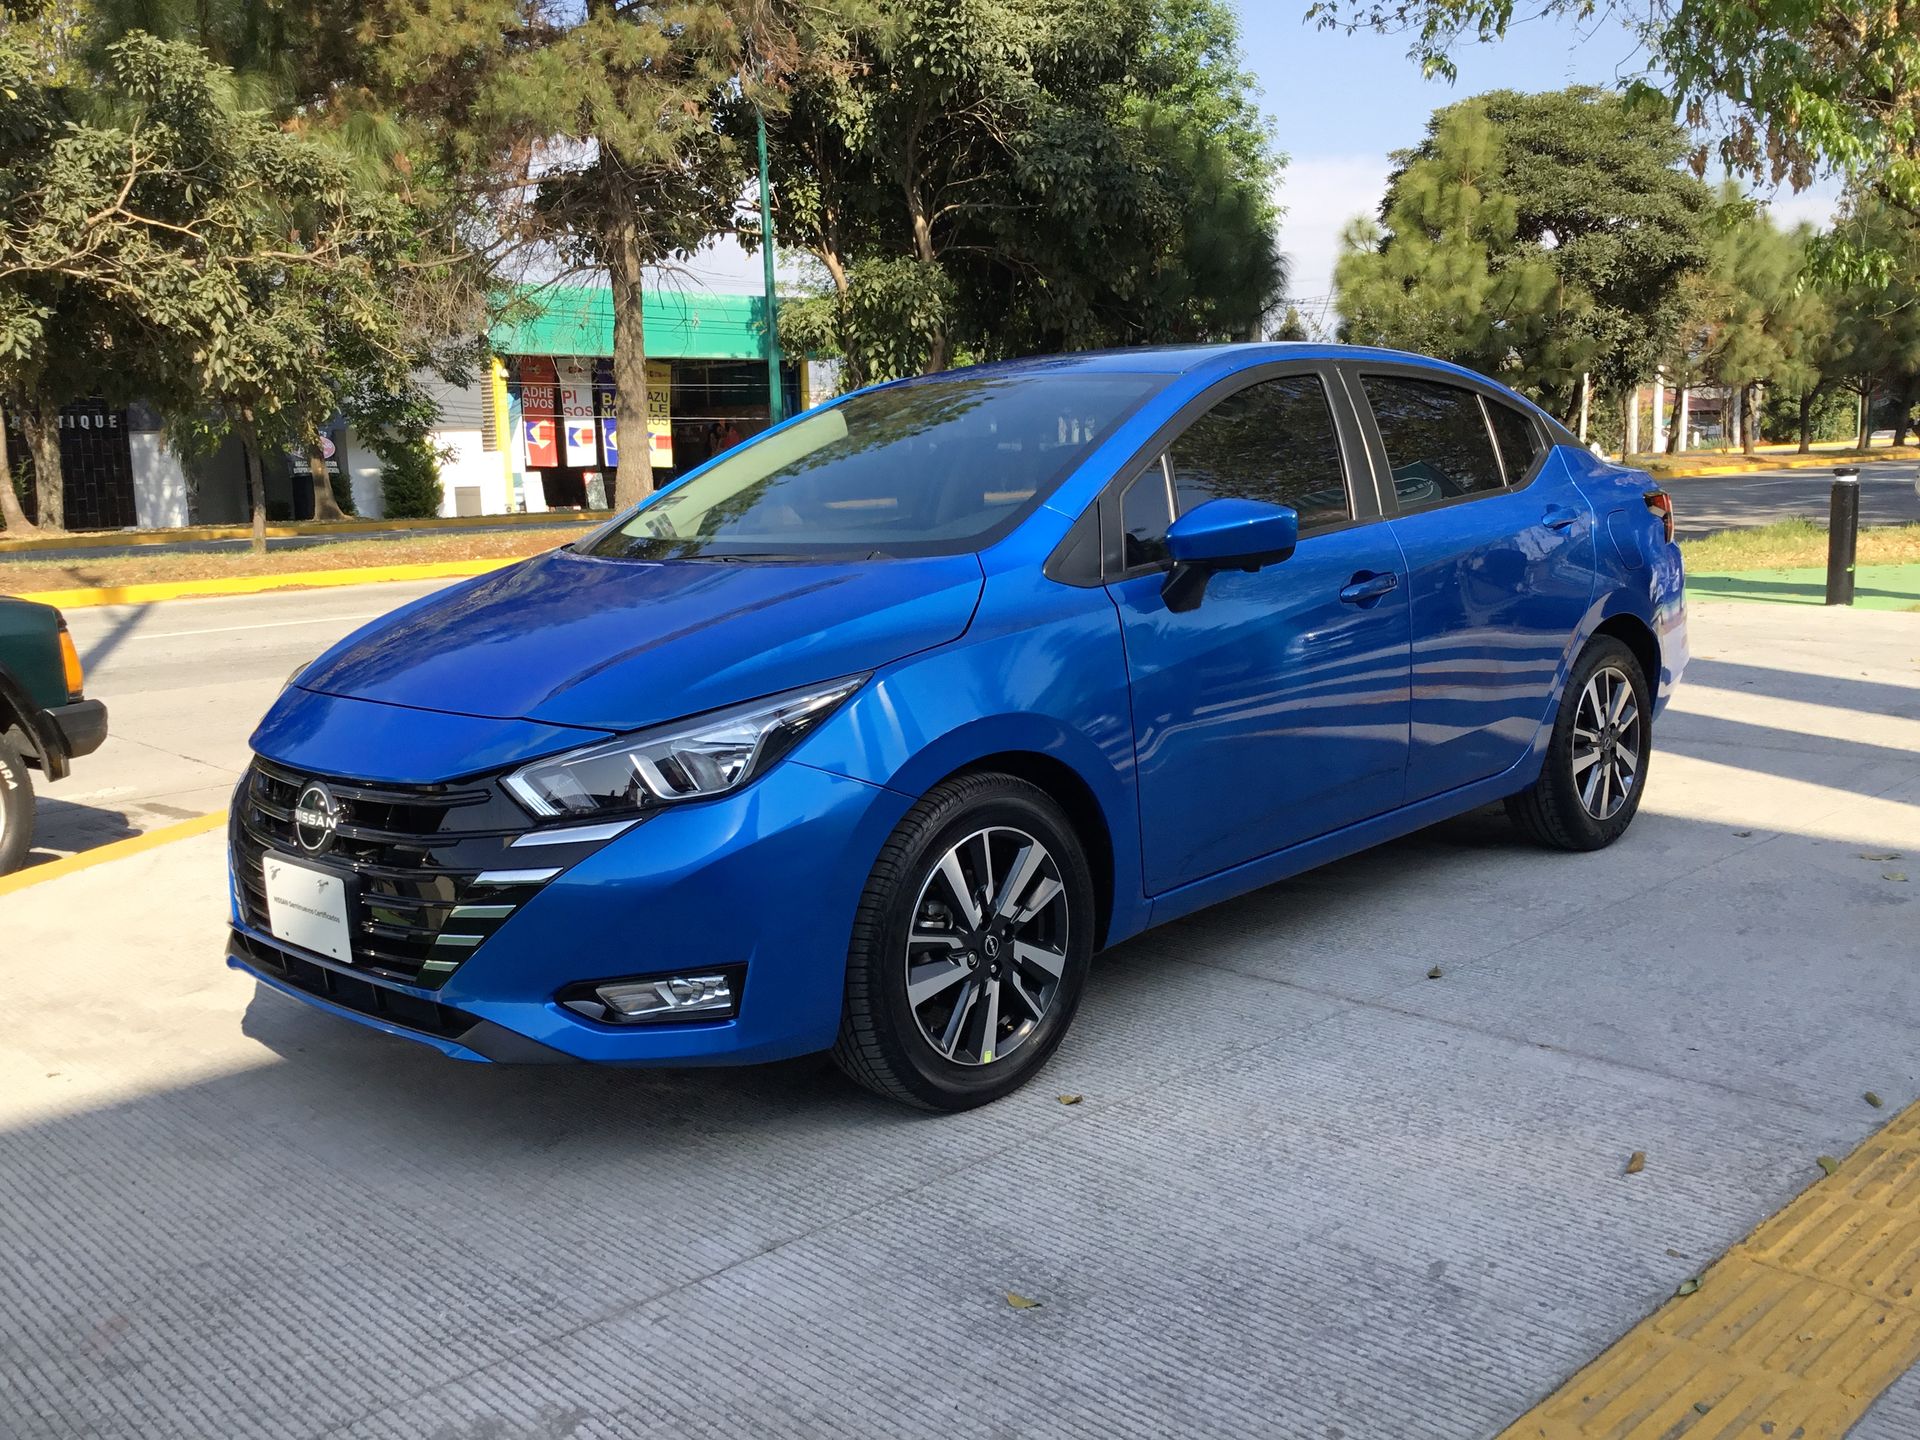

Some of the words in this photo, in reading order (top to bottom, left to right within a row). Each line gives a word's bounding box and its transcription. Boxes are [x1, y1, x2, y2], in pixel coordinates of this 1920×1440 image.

[522, 386, 554, 399] ADHE
[562, 390, 577, 404] PI
[647, 391, 668, 403] AZU
[523, 398, 554, 409] SIVOS
[649, 403, 668, 413] LE
[563, 406, 593, 417] SOS
[11, 415, 118, 430] BTIQUE
[295, 808, 337, 829] NISSAN
